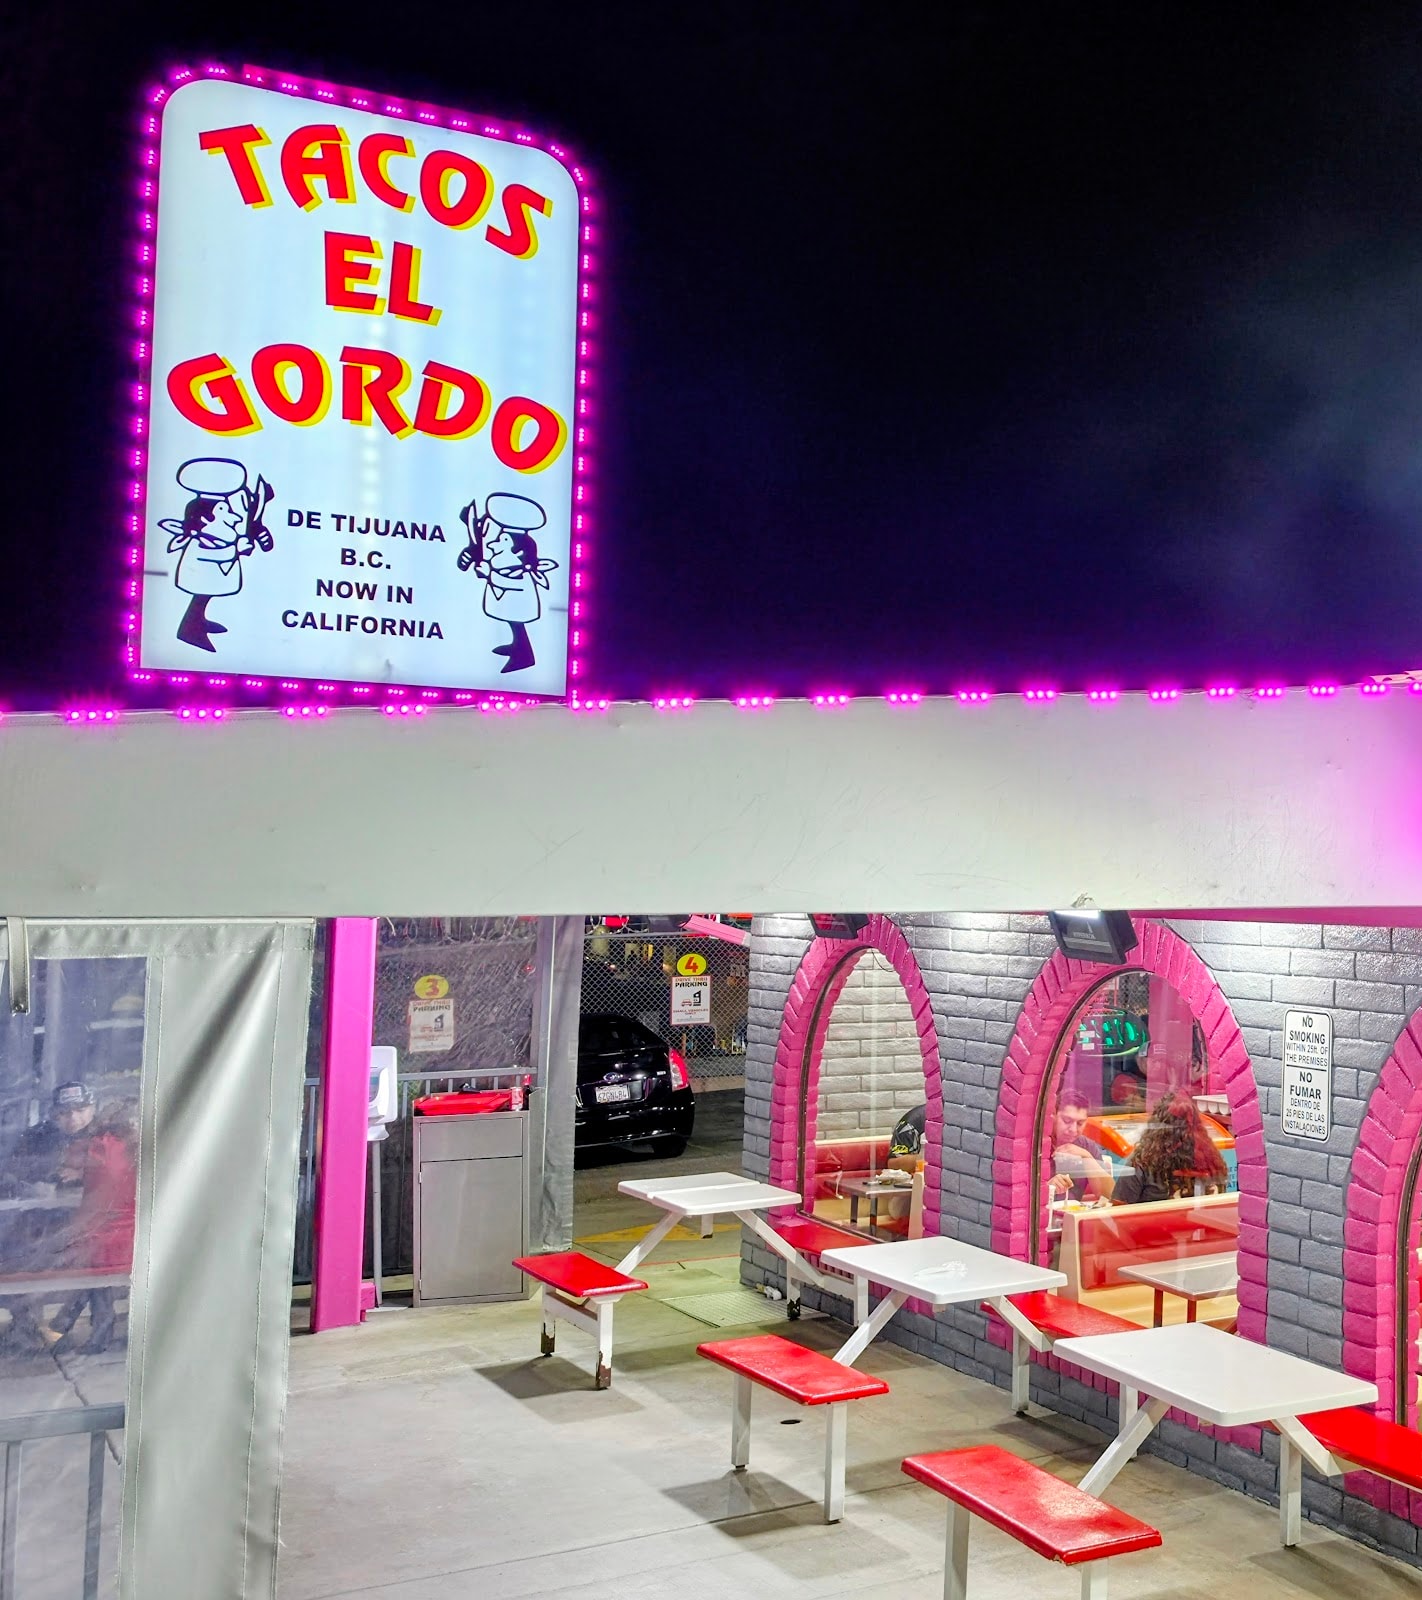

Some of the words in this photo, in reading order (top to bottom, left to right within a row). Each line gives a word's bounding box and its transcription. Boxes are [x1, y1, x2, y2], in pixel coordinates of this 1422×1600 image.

[199, 123, 553, 259] TACOS
[323, 230, 442, 326] EL
[167, 343, 568, 474] GORDO
[287, 508, 322, 530] DE
[331, 513, 446, 543] TIJUANA
[340, 547, 391, 570] B.C.
[316, 578, 378, 601] NOW
[387, 585, 413, 604] IN
[281, 609, 444, 640] CALIFORNIA
[685, 956, 699, 973] 4
[425, 978, 440, 996] 3
[1302, 1016, 1313, 1028] NO
[1289, 1030, 1326, 1045] SMOKING
[1286, 1042, 1306, 1053] WITHIN
[1320, 1046, 1328, 1055] OF
[1286, 1053, 1297, 1063] THE
[1298, 1054, 1328, 1067] PREMISES
[1299, 1071, 1313, 1083] NO
[1290, 1084, 1322, 1100] FUMAR
[1290, 1098, 1312, 1109] DENTRO
[1313, 1101, 1321, 1111] DE
[1293, 1109, 1305, 1120] PIES
[1306, 1111, 1313, 1121] DE
[1314, 1113, 1325, 1123] LAS
[1285, 1120, 1326, 1135] INSTALACIONES
